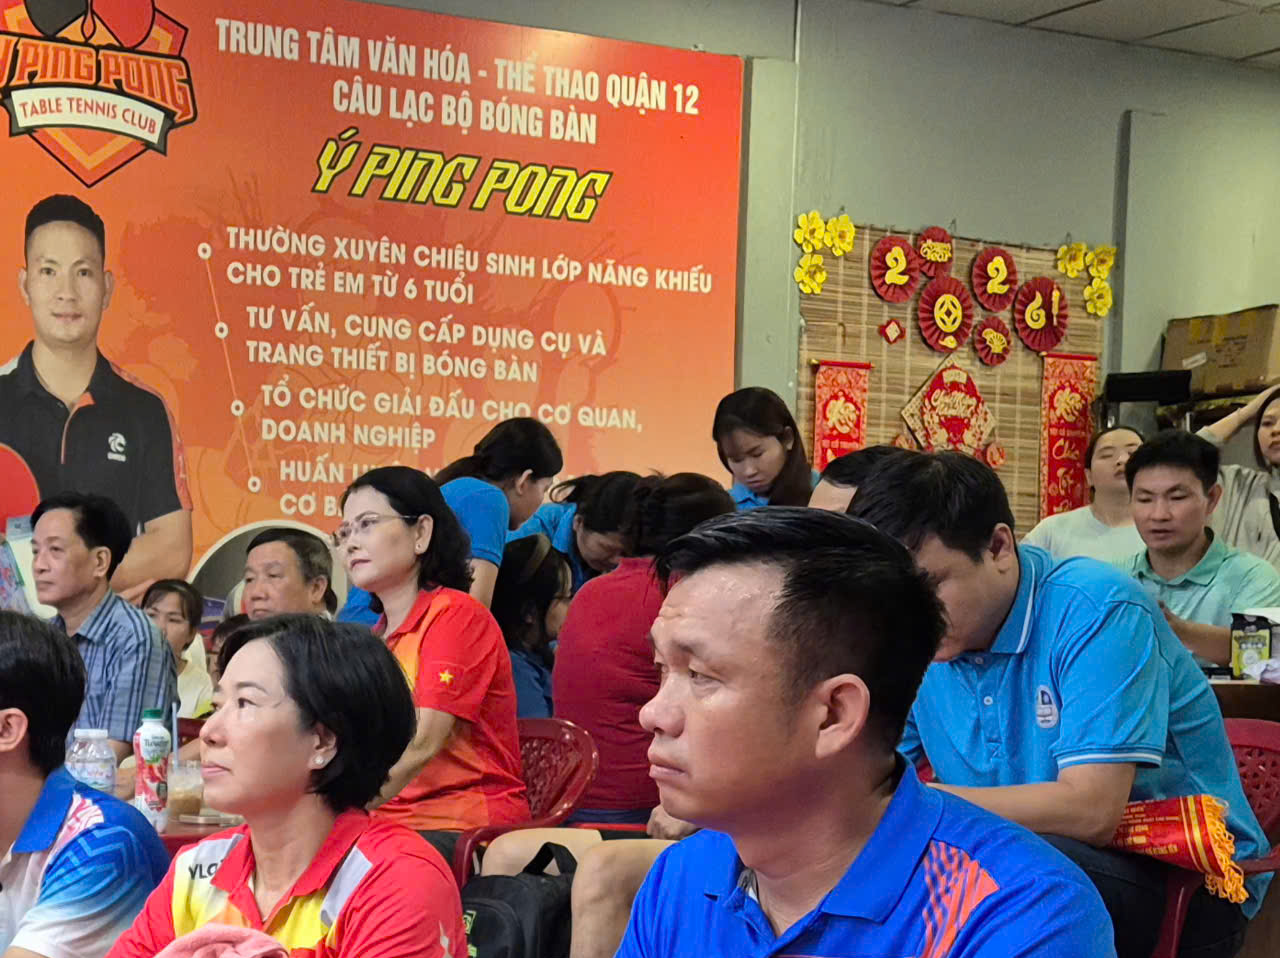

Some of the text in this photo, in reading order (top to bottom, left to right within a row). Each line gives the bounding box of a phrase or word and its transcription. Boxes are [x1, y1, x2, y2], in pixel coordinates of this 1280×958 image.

[9, 37, 96, 85] PING
[98, 49, 194, 122] PONG
[216, 18, 299, 61] TRUNG
[307, 26, 360, 69] TÂM
[367, 35, 416, 77] VĂN
[424, 42, 471, 85] HÓA
[494, 49, 537, 94] THỂ
[543, 65, 599, 102] THAO
[606, 71, 666, 115] QUẬN
[673, 84, 700, 115] 12
[20, 97, 156, 135] TABLE TENNIS CLUB
[333, 75, 597, 144] CÂU LẠC BỘ BÓNG BÀN
[312, 127, 613, 223] Ý PING PONG
[226, 225, 713, 294] THƯỜNG XUYÊN CHIÊU SINH LỚP NĂNG KHIẾU
[226, 261, 474, 305] CHO TRẺ EM TỪ 6 TUỔI
[885, 246, 910, 286] 2
[987, 255, 1010, 294] 2
[246, 301, 607, 359] TƯ VẤN, CUNG CẤP DỤNG CỤ VÀ
[246, 340, 538, 384] TRANG THIẾT BỊ BÓNG BÀN
[261, 373, 643, 433] TỔ CHỨC GIẢI ĐẤU CHO CƠ QUAN,
[261, 419, 436, 450] DOANH NGHIỆP
[279, 452, 345, 483] HUẤN
[279, 492, 317, 516] CƠ
